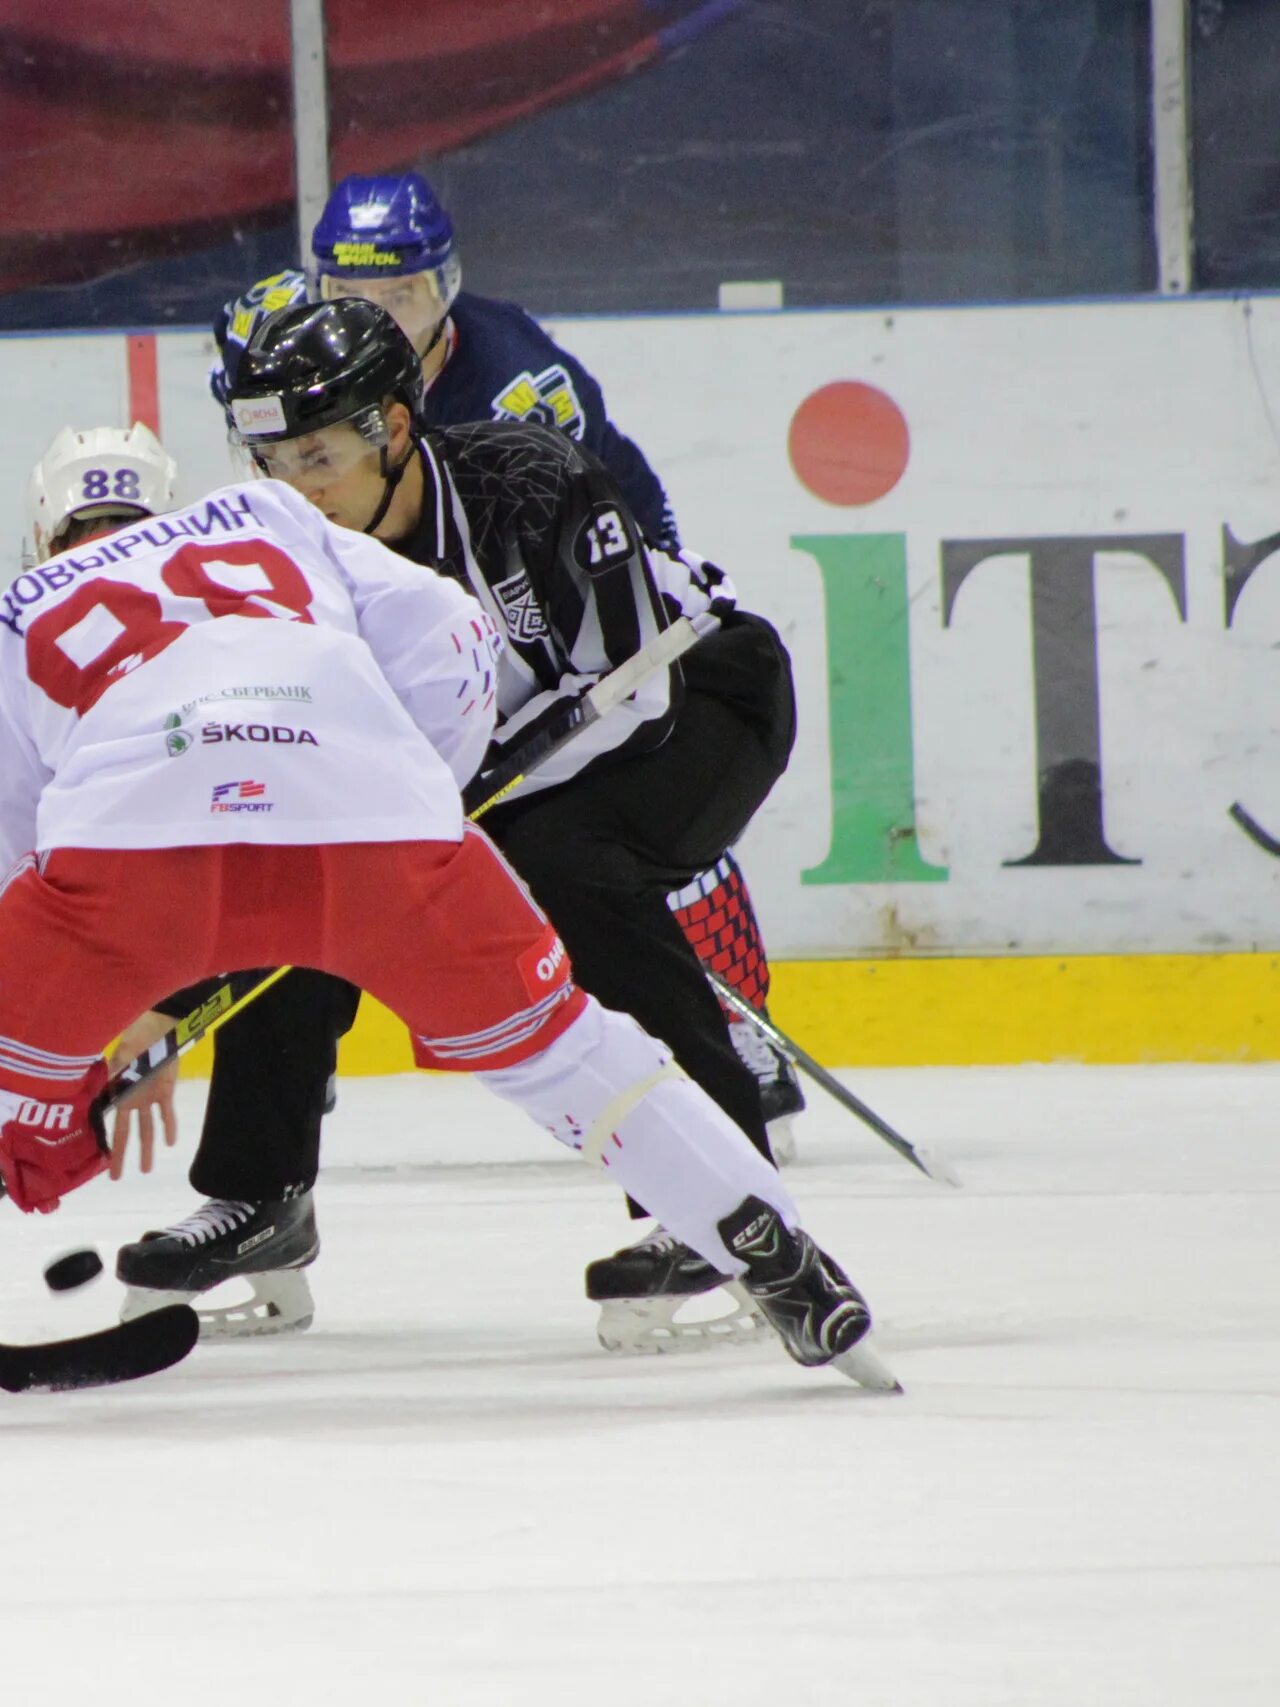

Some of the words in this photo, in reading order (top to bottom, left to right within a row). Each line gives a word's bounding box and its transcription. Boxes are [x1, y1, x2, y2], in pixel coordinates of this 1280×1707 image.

[82, 469, 141, 500] 88
[586, 510, 629, 564] 13
[787, 380, 1280, 885] iT
[202, 721, 320, 747] ŠKODA
